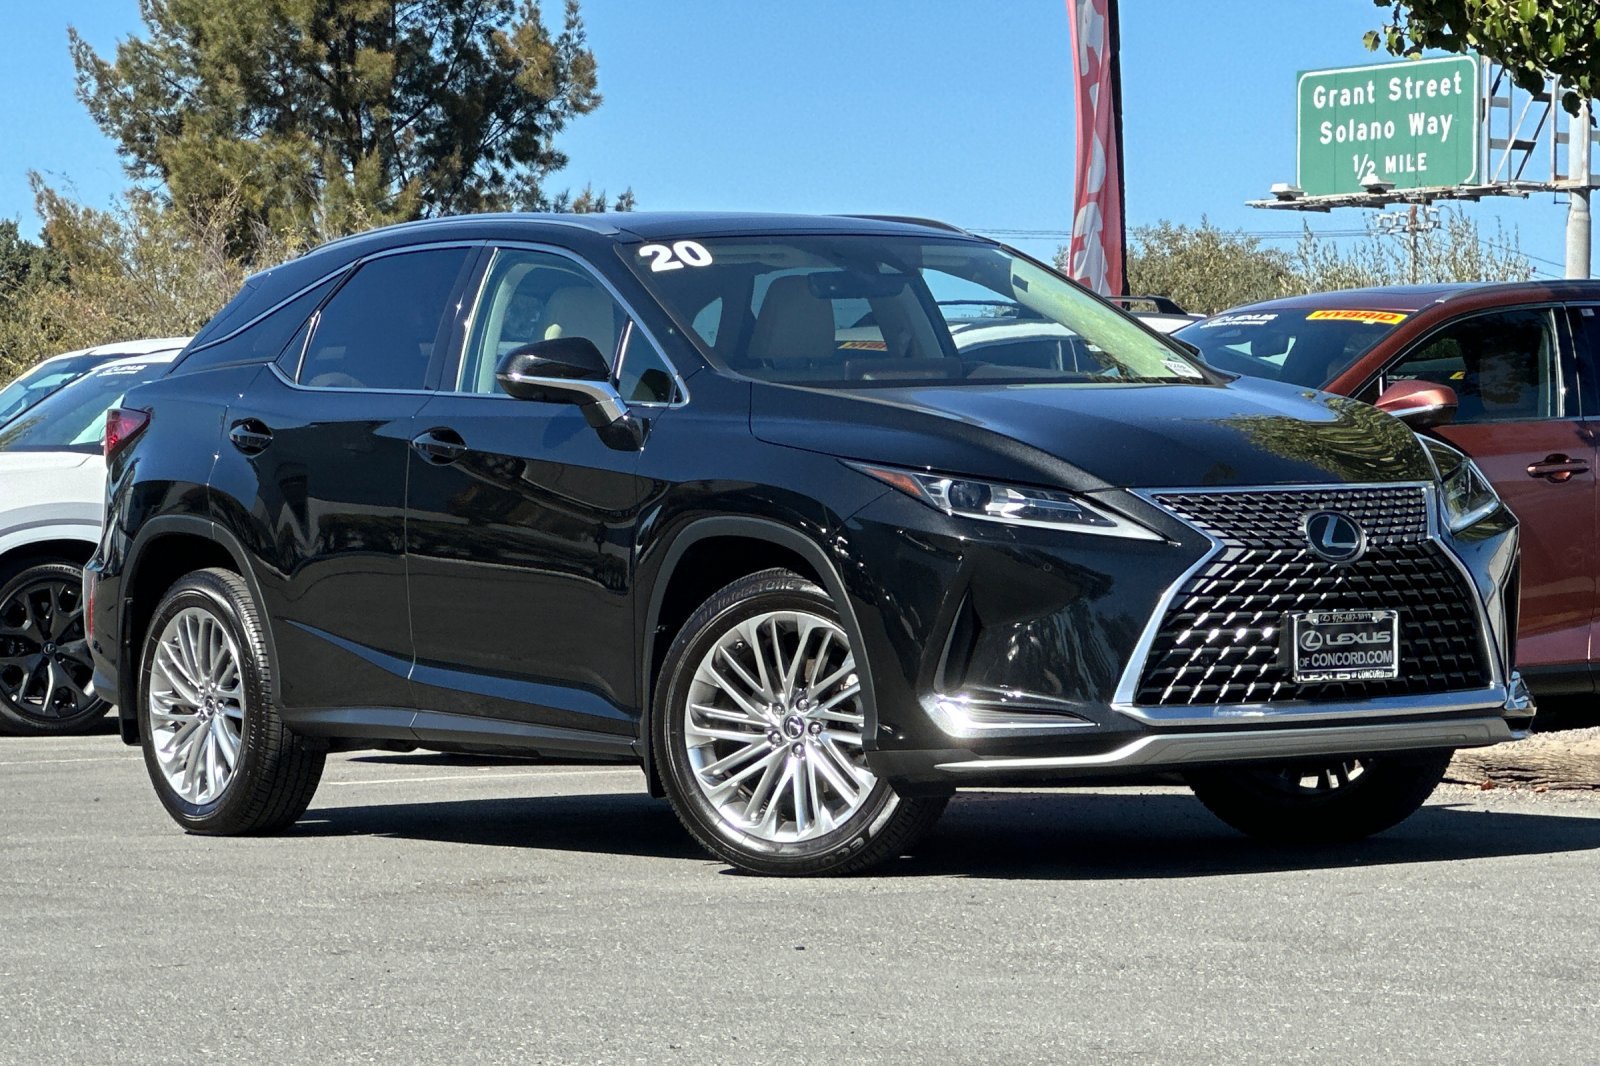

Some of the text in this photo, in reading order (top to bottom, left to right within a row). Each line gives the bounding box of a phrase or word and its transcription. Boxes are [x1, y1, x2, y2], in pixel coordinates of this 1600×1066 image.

[1313, 70, 1462, 109] Grant Street
[1319, 112, 1453, 145] Solano Way
[1385, 152, 1428, 174] MILE
[639, 240, 713, 273] 20
[1314, 310, 1398, 321] HYBRID
[1325, 631, 1391, 646] LEXUS
[1300, 650, 1393, 667] OF CONCORD.COM
